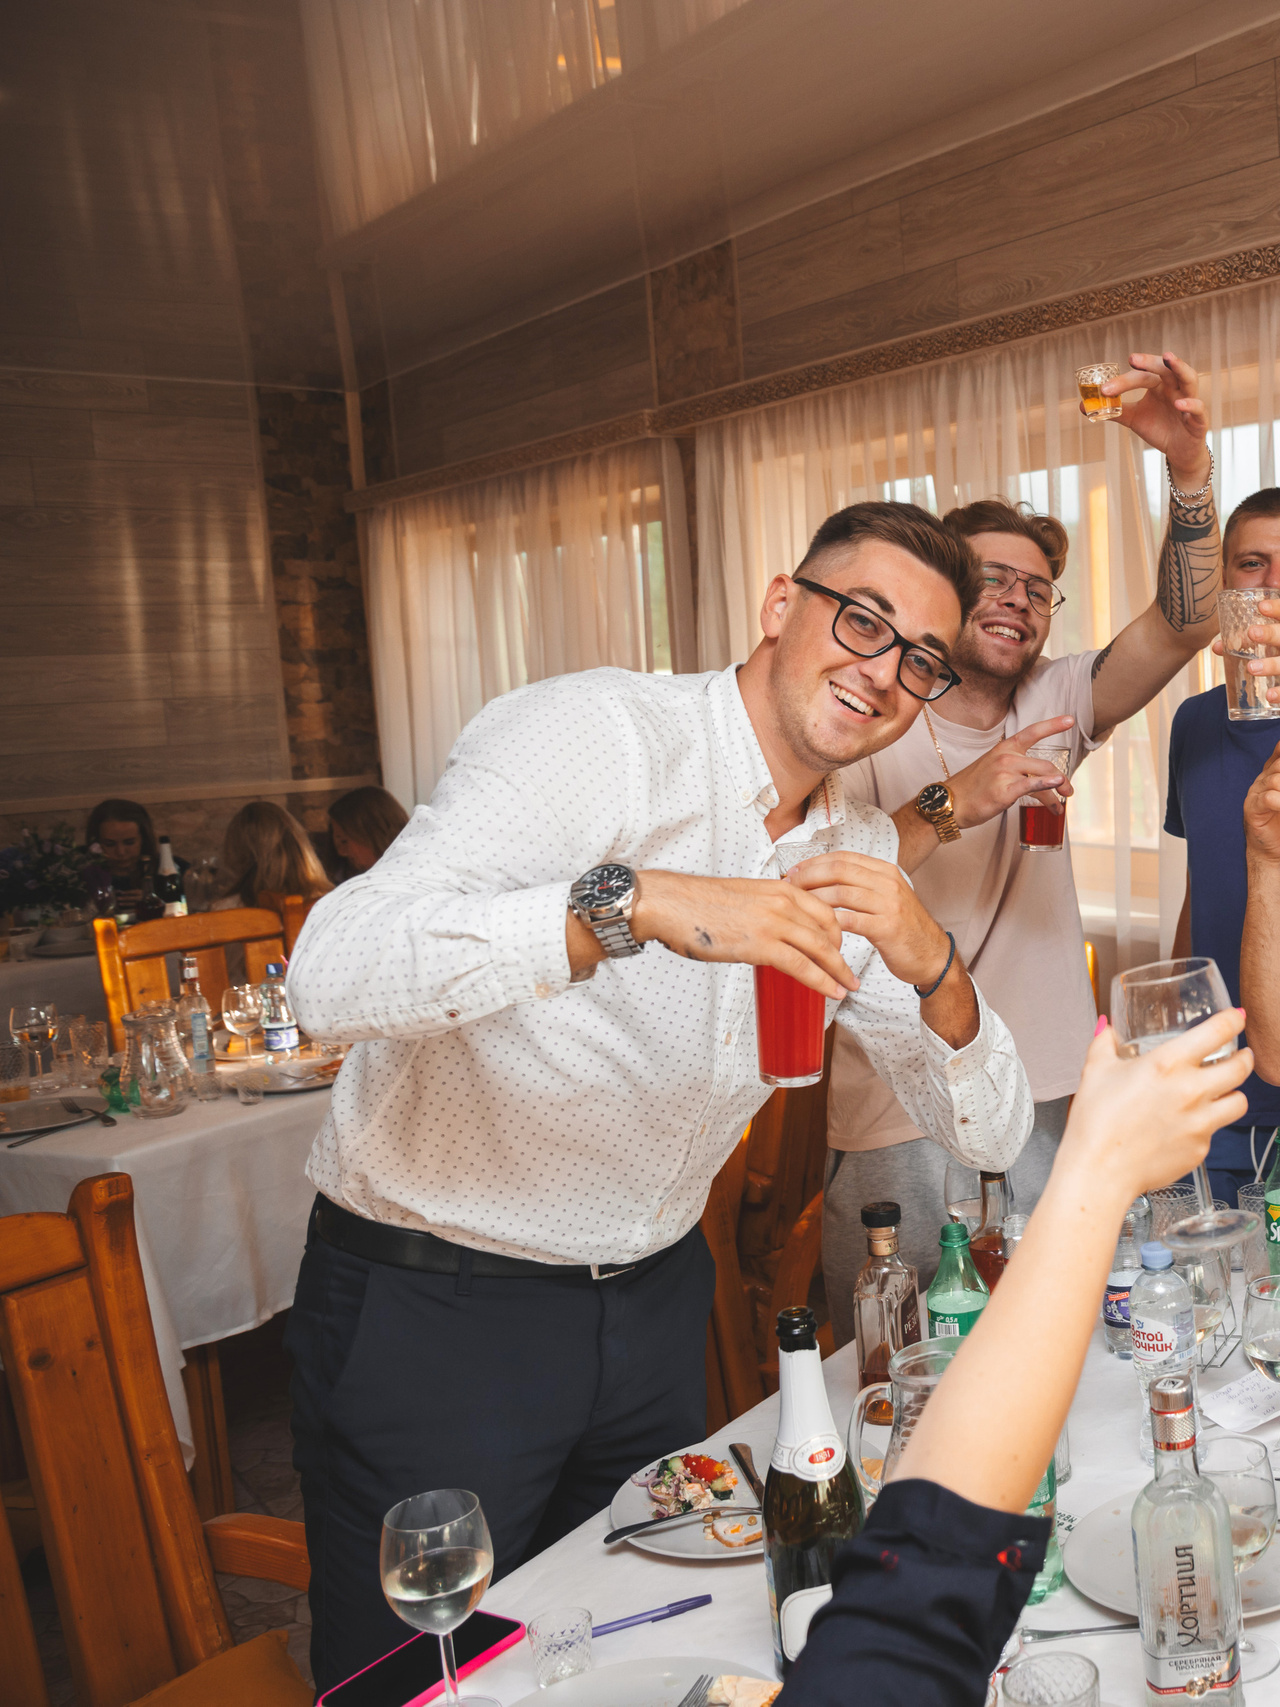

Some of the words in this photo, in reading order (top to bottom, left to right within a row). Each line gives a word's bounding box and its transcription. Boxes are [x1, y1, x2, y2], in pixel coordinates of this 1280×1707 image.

[1131, 1324, 1164, 1342] ВЯТОЙ
[1132, 1336, 1173, 1353] ТОЧНИК
[814, 1449, 831, 1463] 1831
[1168, 1654, 1222, 1668] СЕРЕБРЯНАЯ
[1175, 1661, 1215, 1671] ПРОХЛАДА
